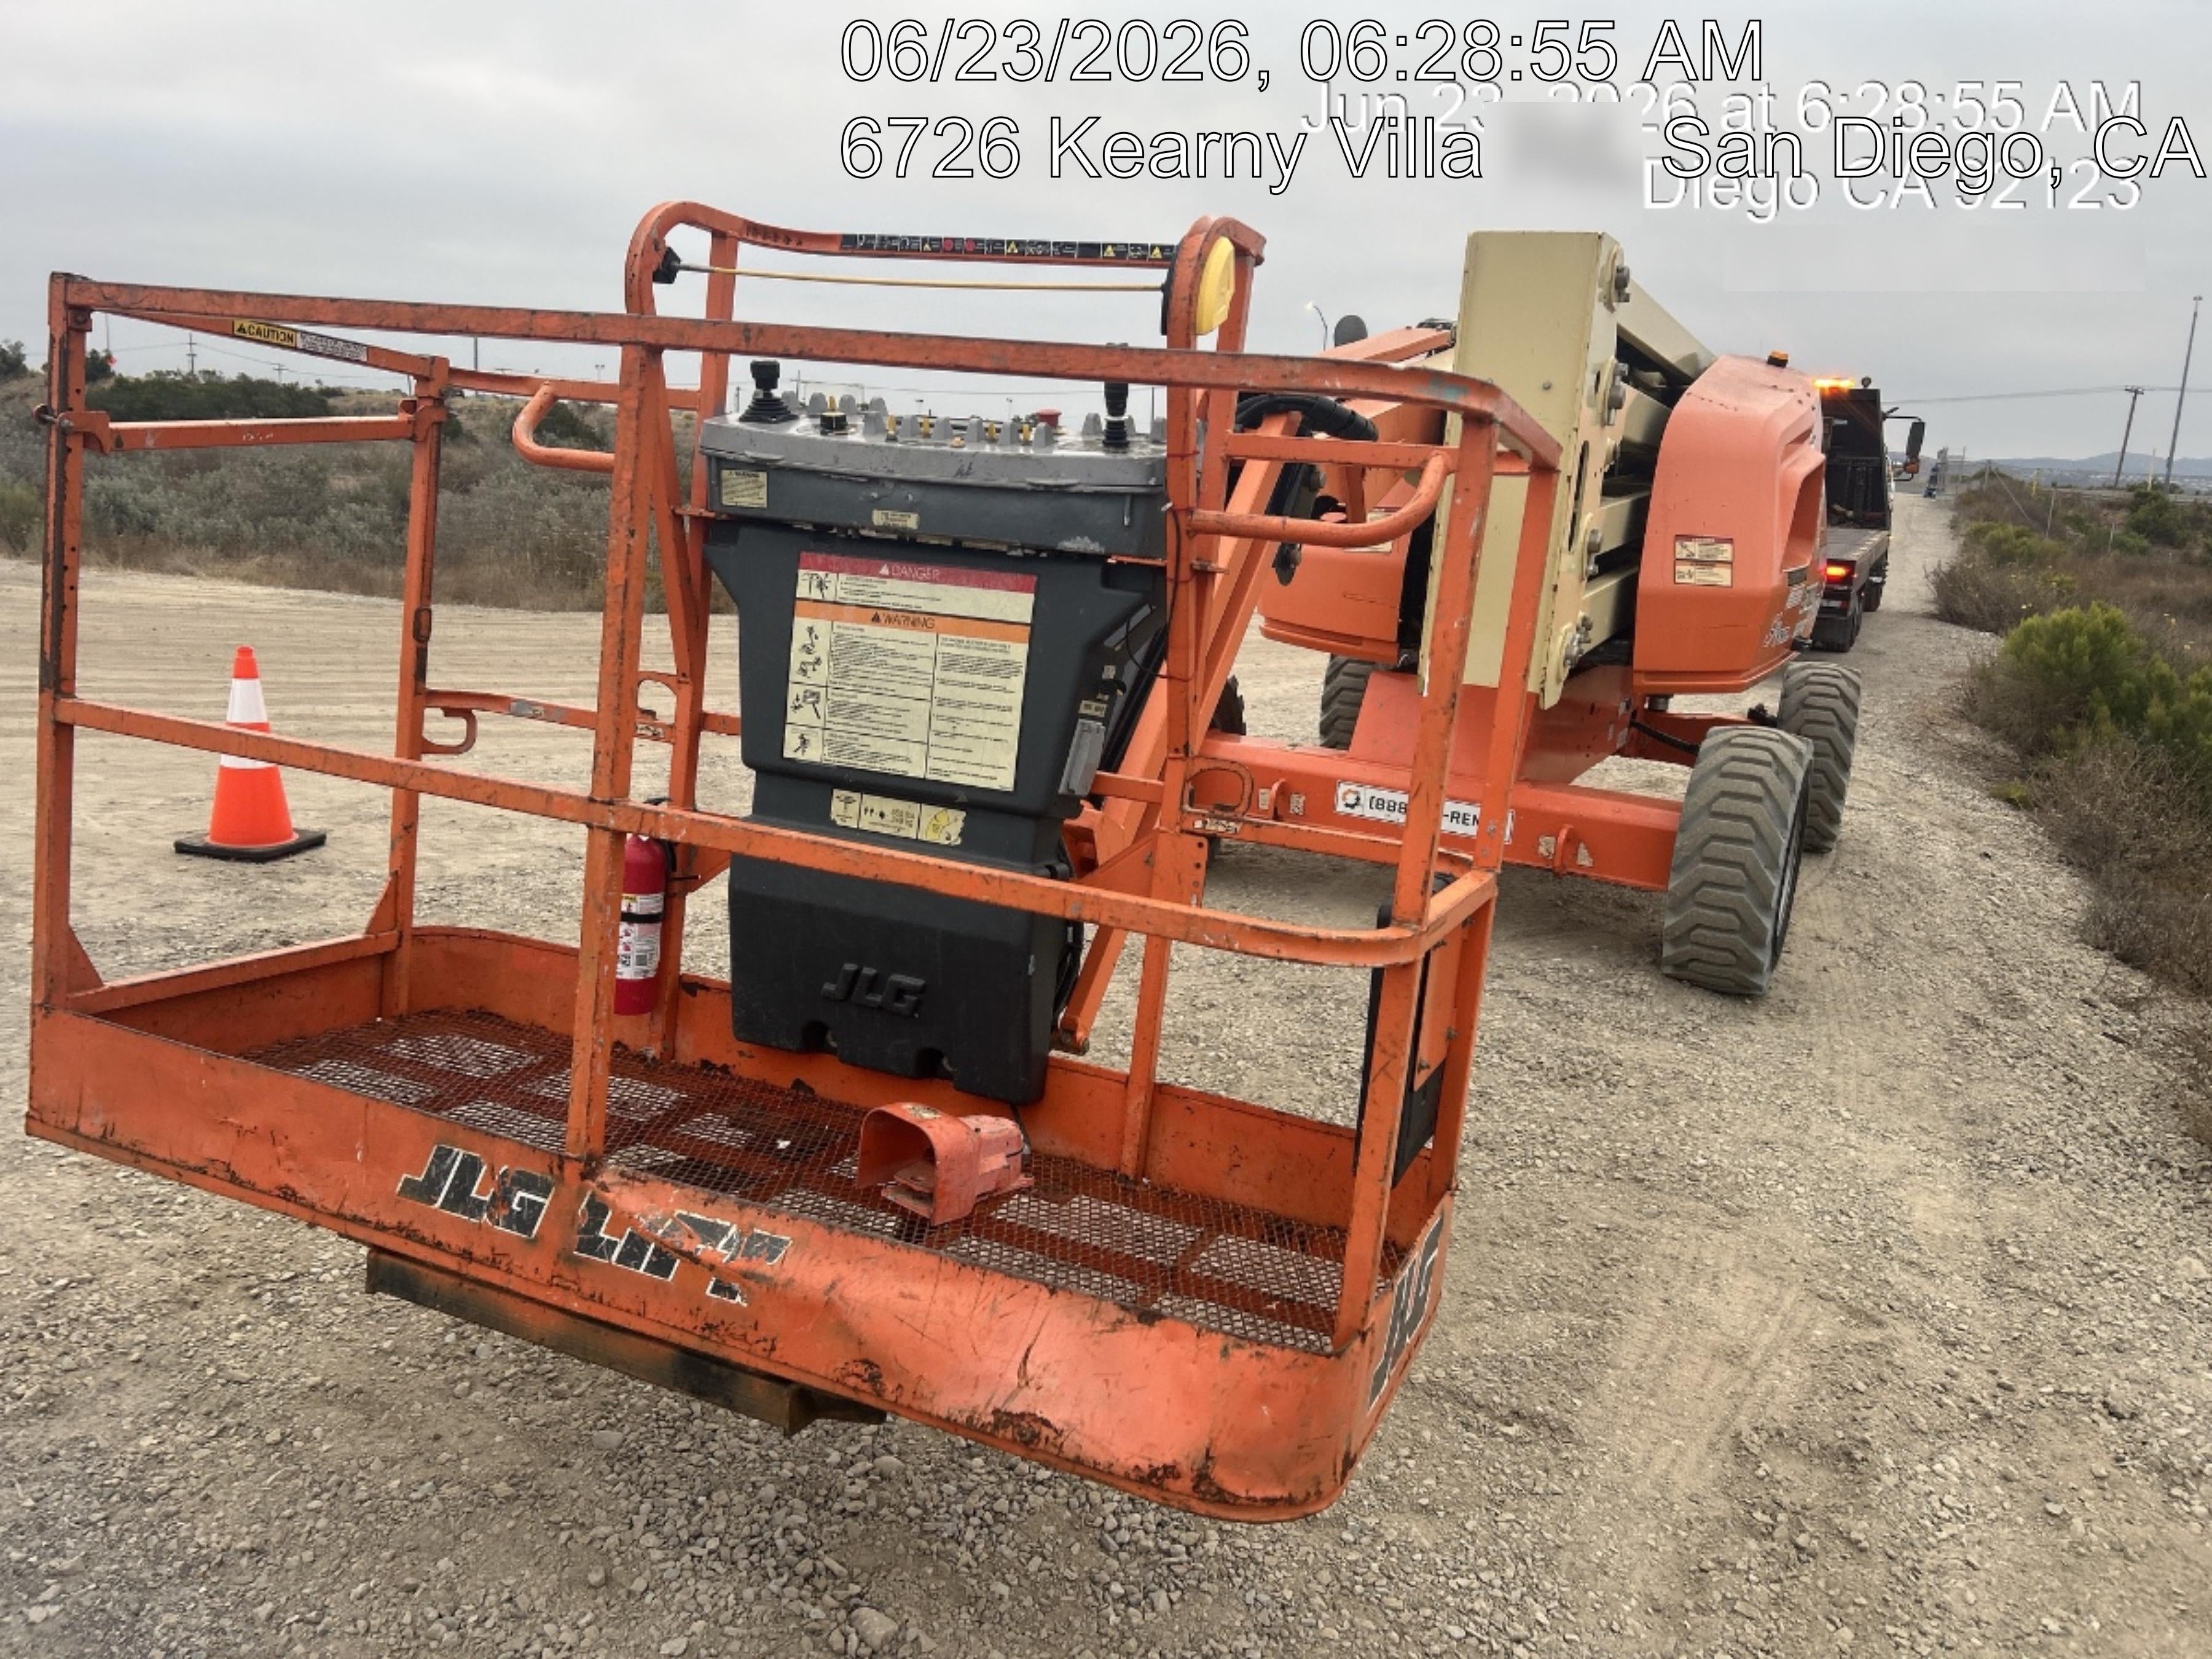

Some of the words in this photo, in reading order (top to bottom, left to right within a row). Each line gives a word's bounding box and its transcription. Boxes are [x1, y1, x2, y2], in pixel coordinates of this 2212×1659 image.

[248, 324, 295, 345] CAUTION
[891, 563, 941, 582] DANGER
[882, 613, 935, 630] WARNING
[820, 962, 927, 1017] JLG
[396, 1143, 555, 1239] JLG
